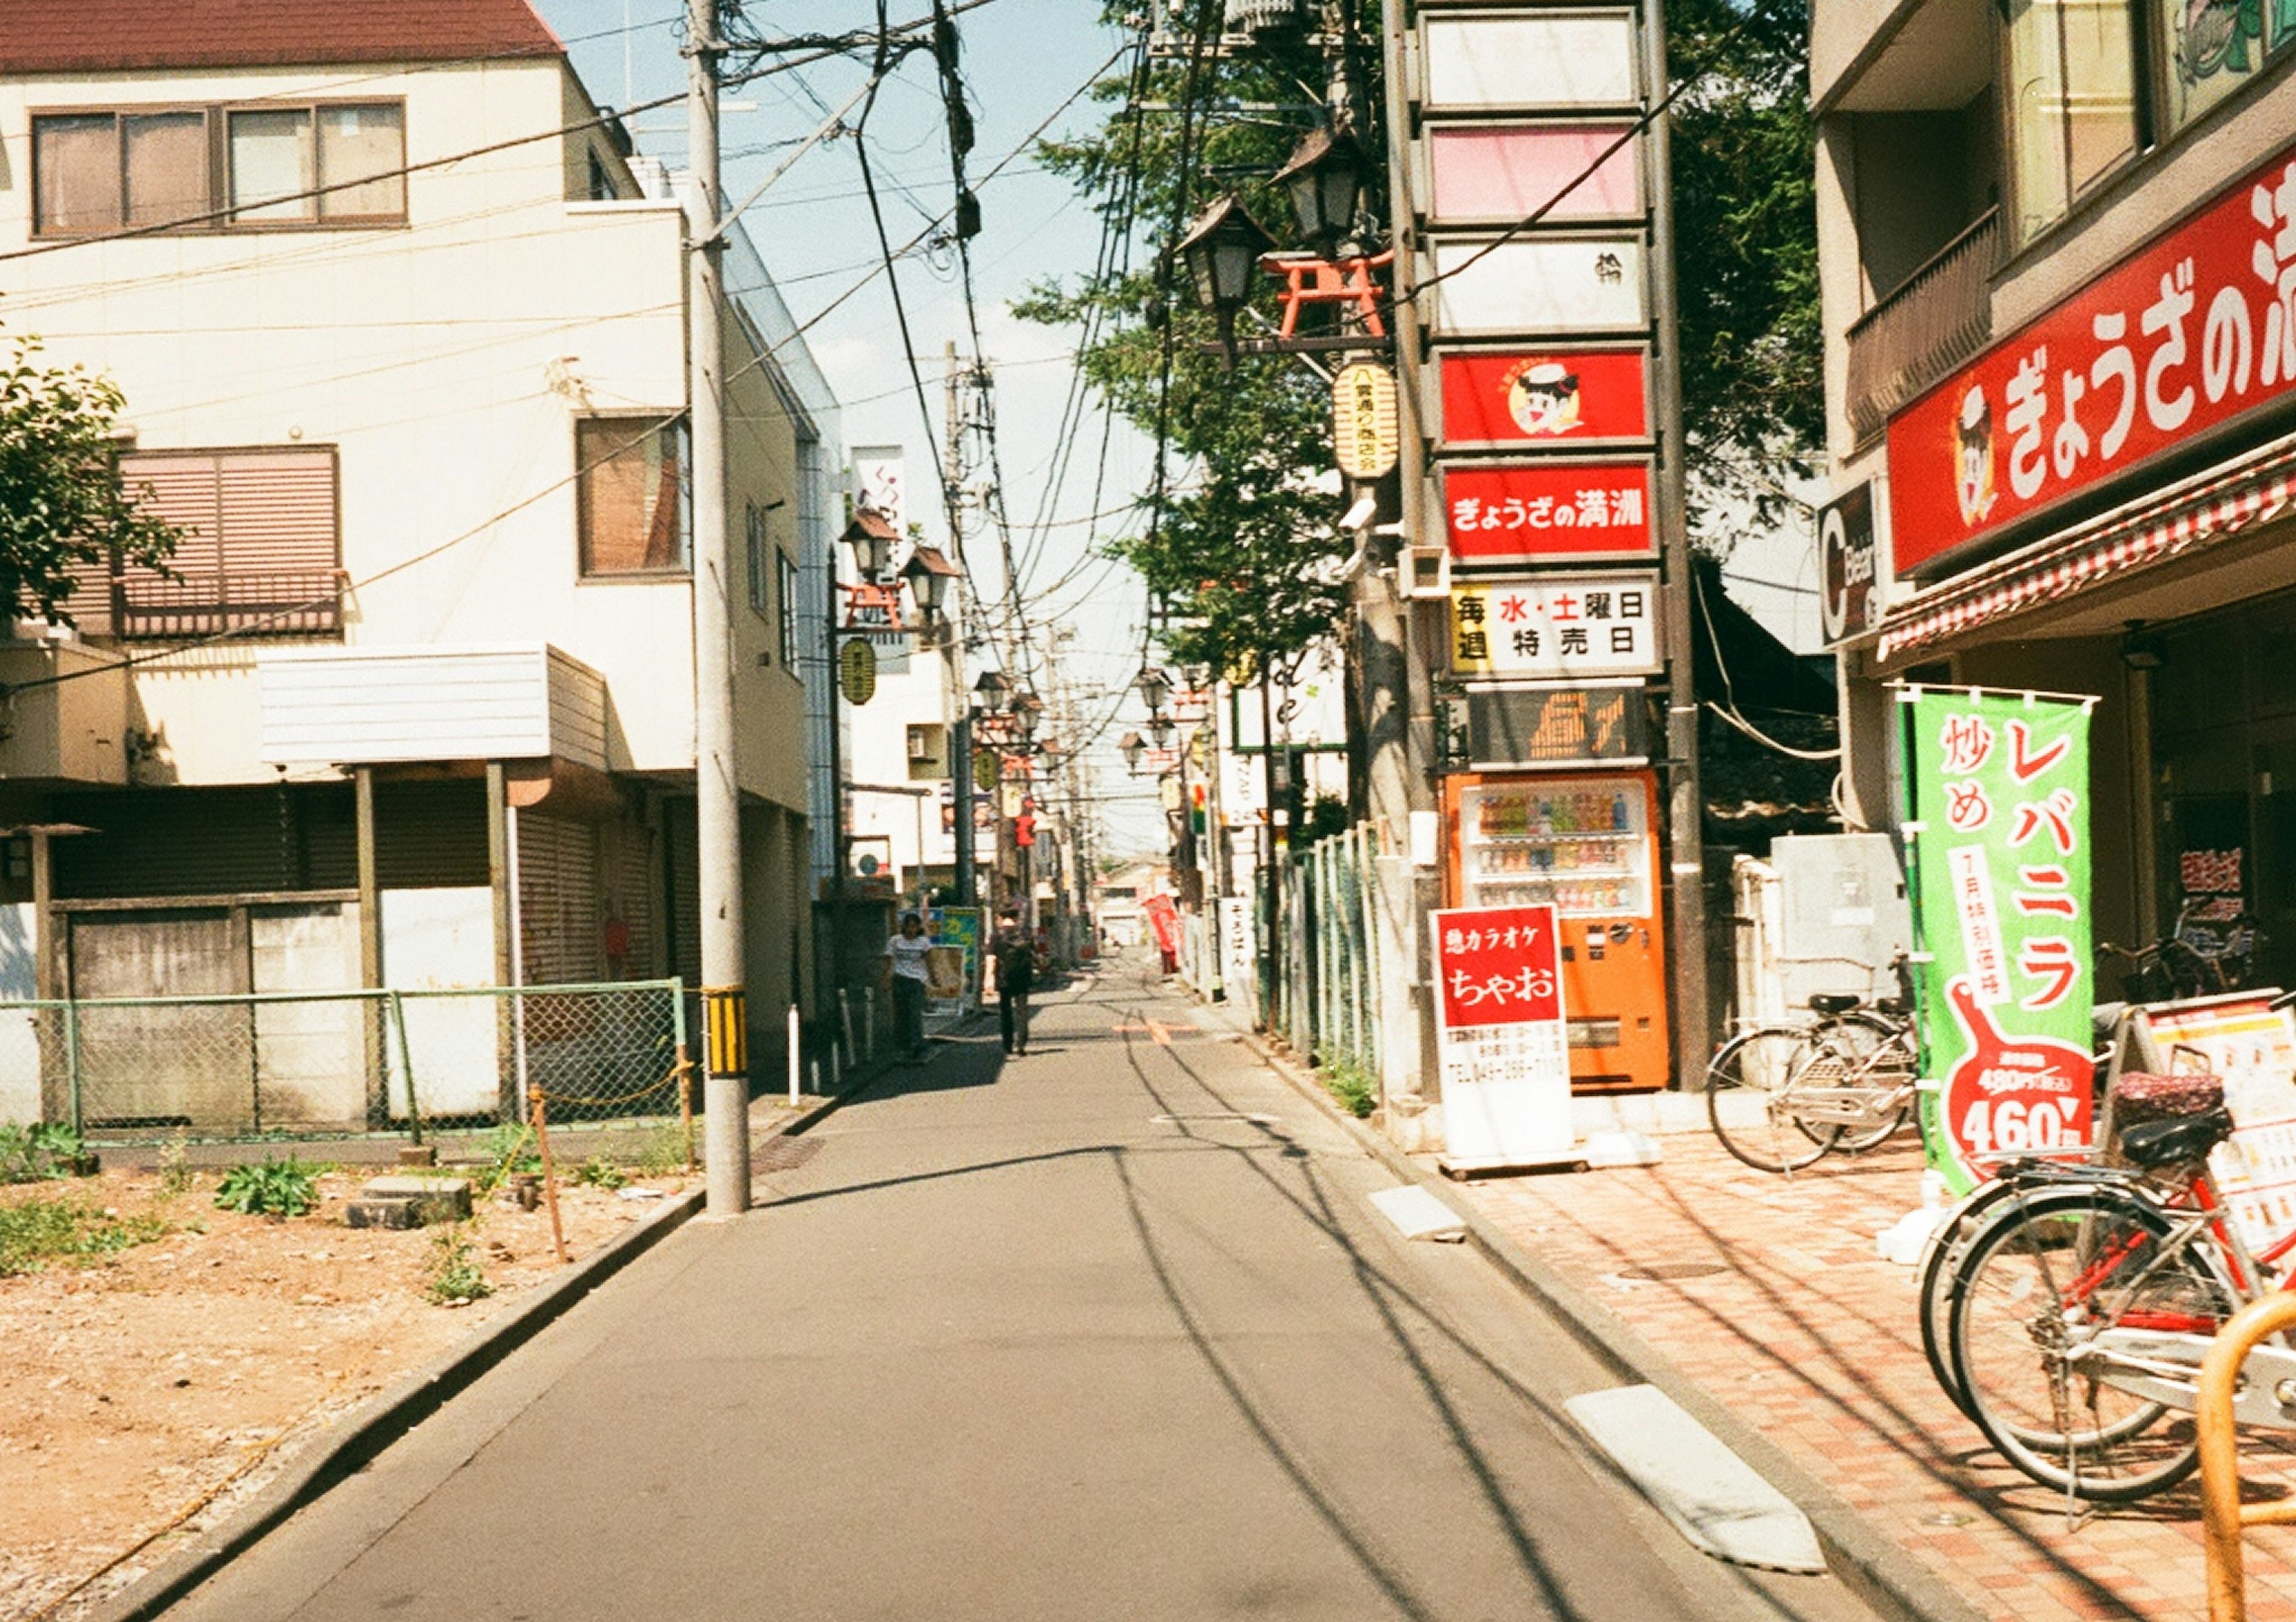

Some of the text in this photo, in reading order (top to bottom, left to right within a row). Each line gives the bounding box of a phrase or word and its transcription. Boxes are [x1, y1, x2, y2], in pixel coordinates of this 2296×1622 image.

[1454, 488, 1642, 530] ぎょうざの満洲
[1457, 594, 1488, 659] 毎週
[1500, 592, 1642, 623] 水・土曜日
[1513, 627, 1634, 656] 特売日
[1944, 717, 1992, 827] 炒め
[2006, 719, 2078, 1010] レバニラ
[1448, 966, 1553, 1006] ちゃお
